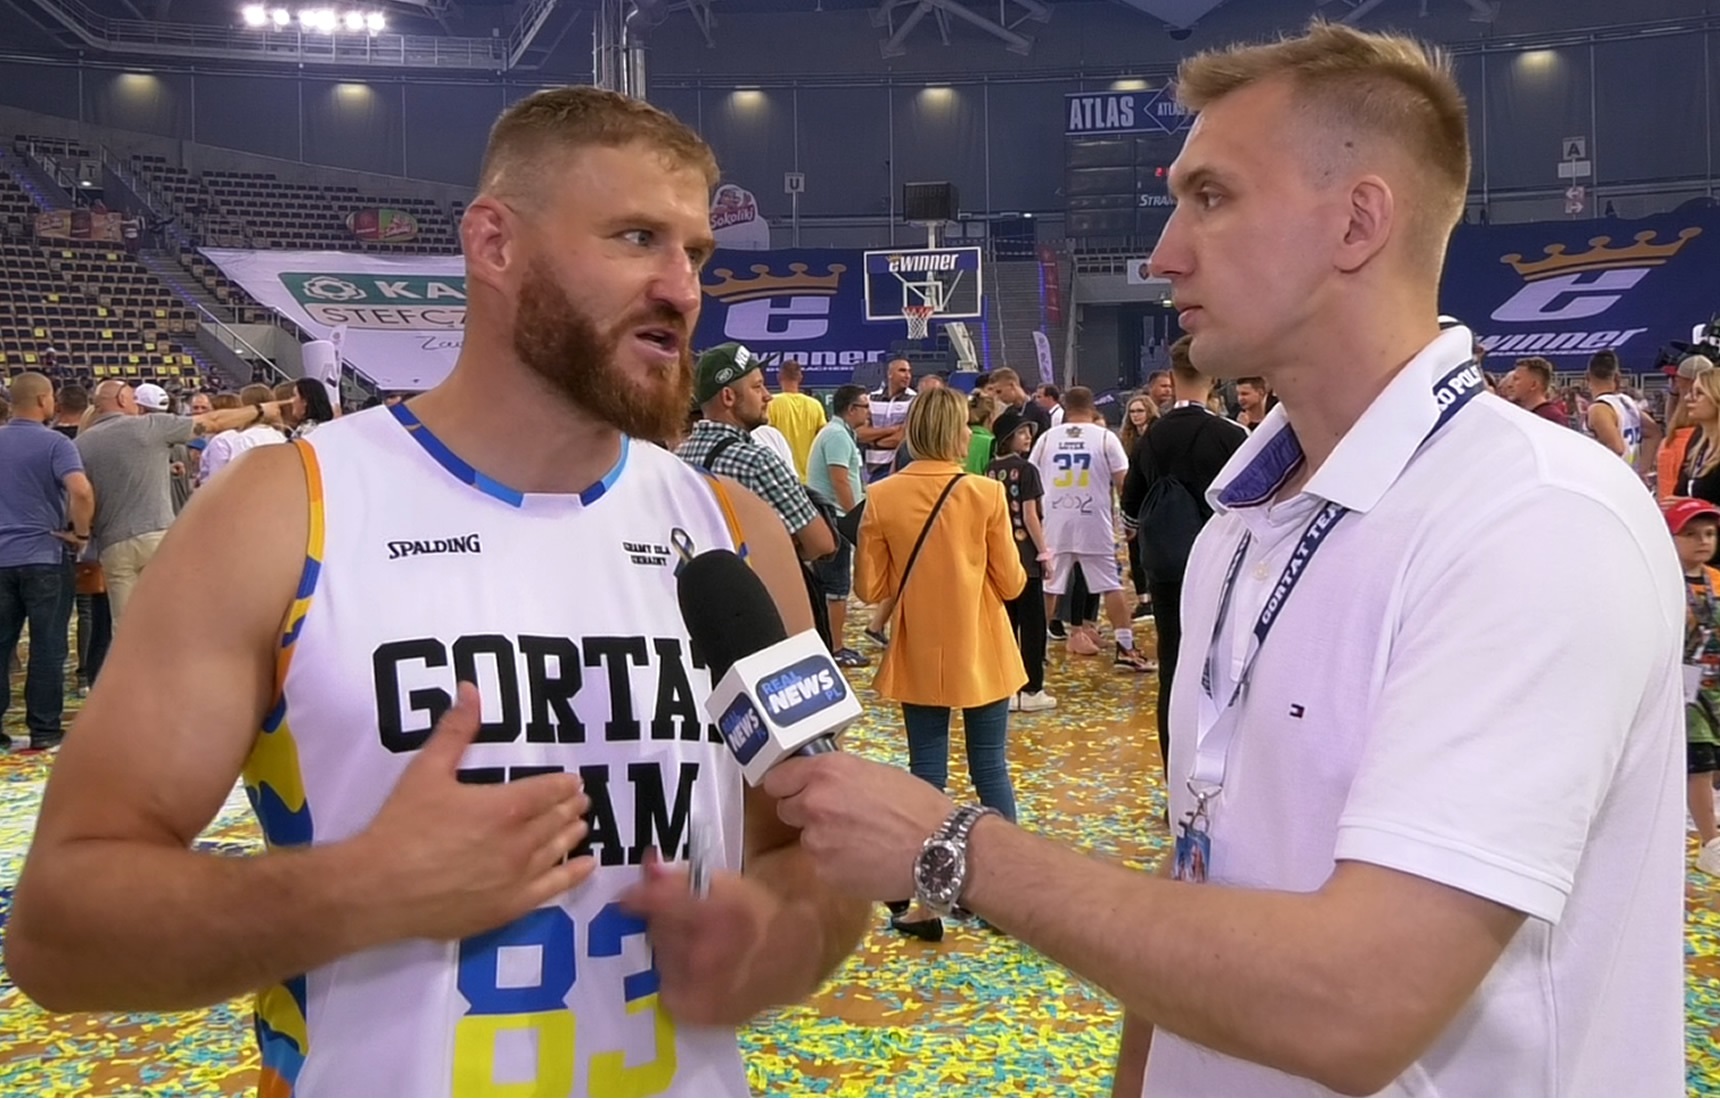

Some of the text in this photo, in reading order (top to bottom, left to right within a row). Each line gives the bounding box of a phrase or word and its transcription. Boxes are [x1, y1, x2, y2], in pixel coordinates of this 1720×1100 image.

[1070, 96, 1134, 130] ATLAS
[1567, 142, 1580, 157] A
[789, 178, 800, 190] U
[374, 280, 467, 299] KA
[1053, 453, 1092, 488] 37
[387, 533, 480, 559] SPALDING
[761, 671, 802, 695] REAL
[768, 668, 835, 715] NEWS
[825, 688, 843, 701] PL
[728, 707, 760, 752] NEWS
[453, 902, 678, 1098] 83
